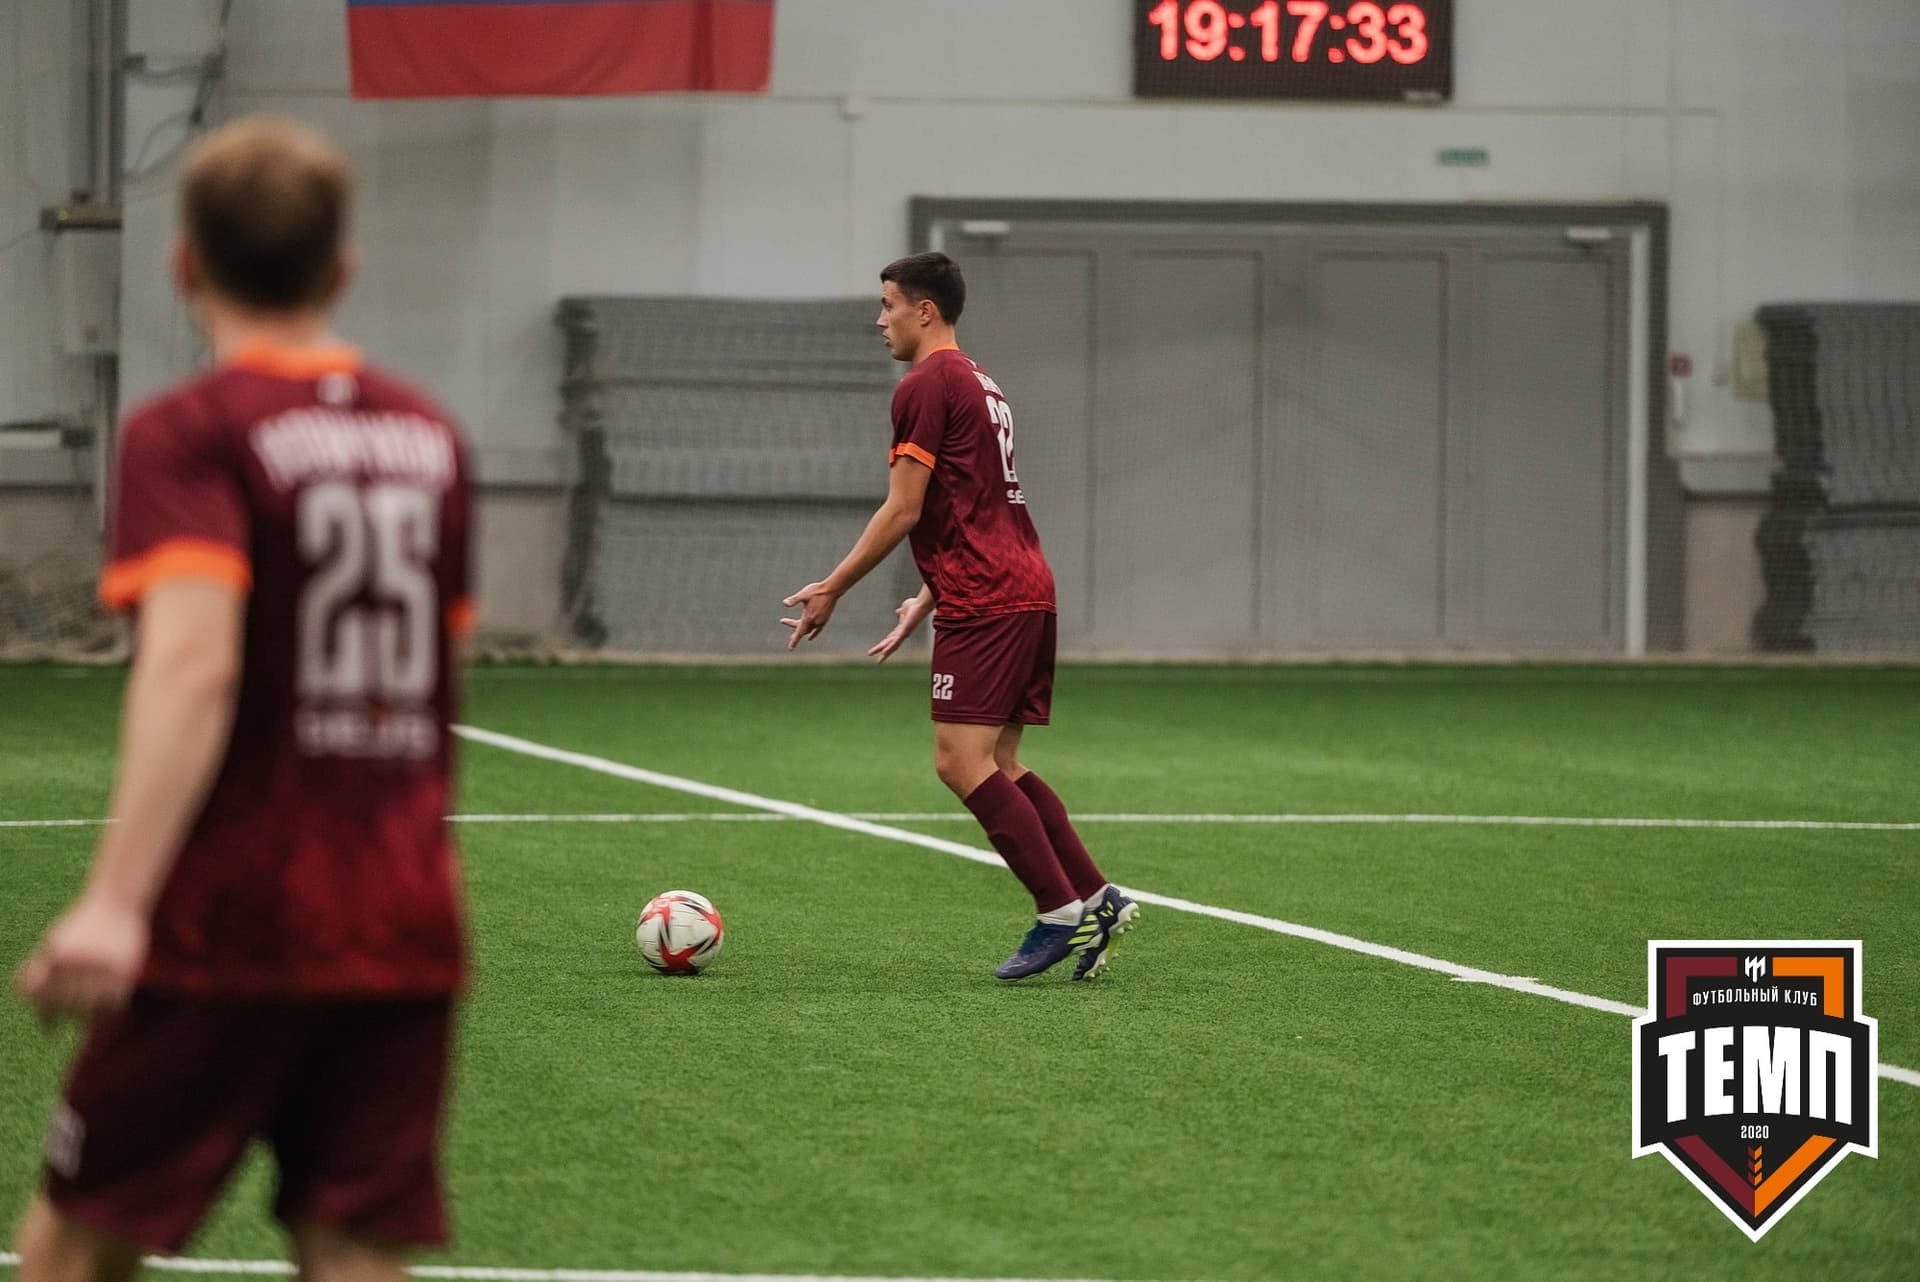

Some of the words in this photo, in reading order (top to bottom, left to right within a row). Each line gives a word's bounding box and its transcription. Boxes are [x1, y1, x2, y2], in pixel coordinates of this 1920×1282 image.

[1149, 0, 1428, 64] 19:17:33
[298, 482, 440, 698] 25
[932, 673, 954, 700] 22
